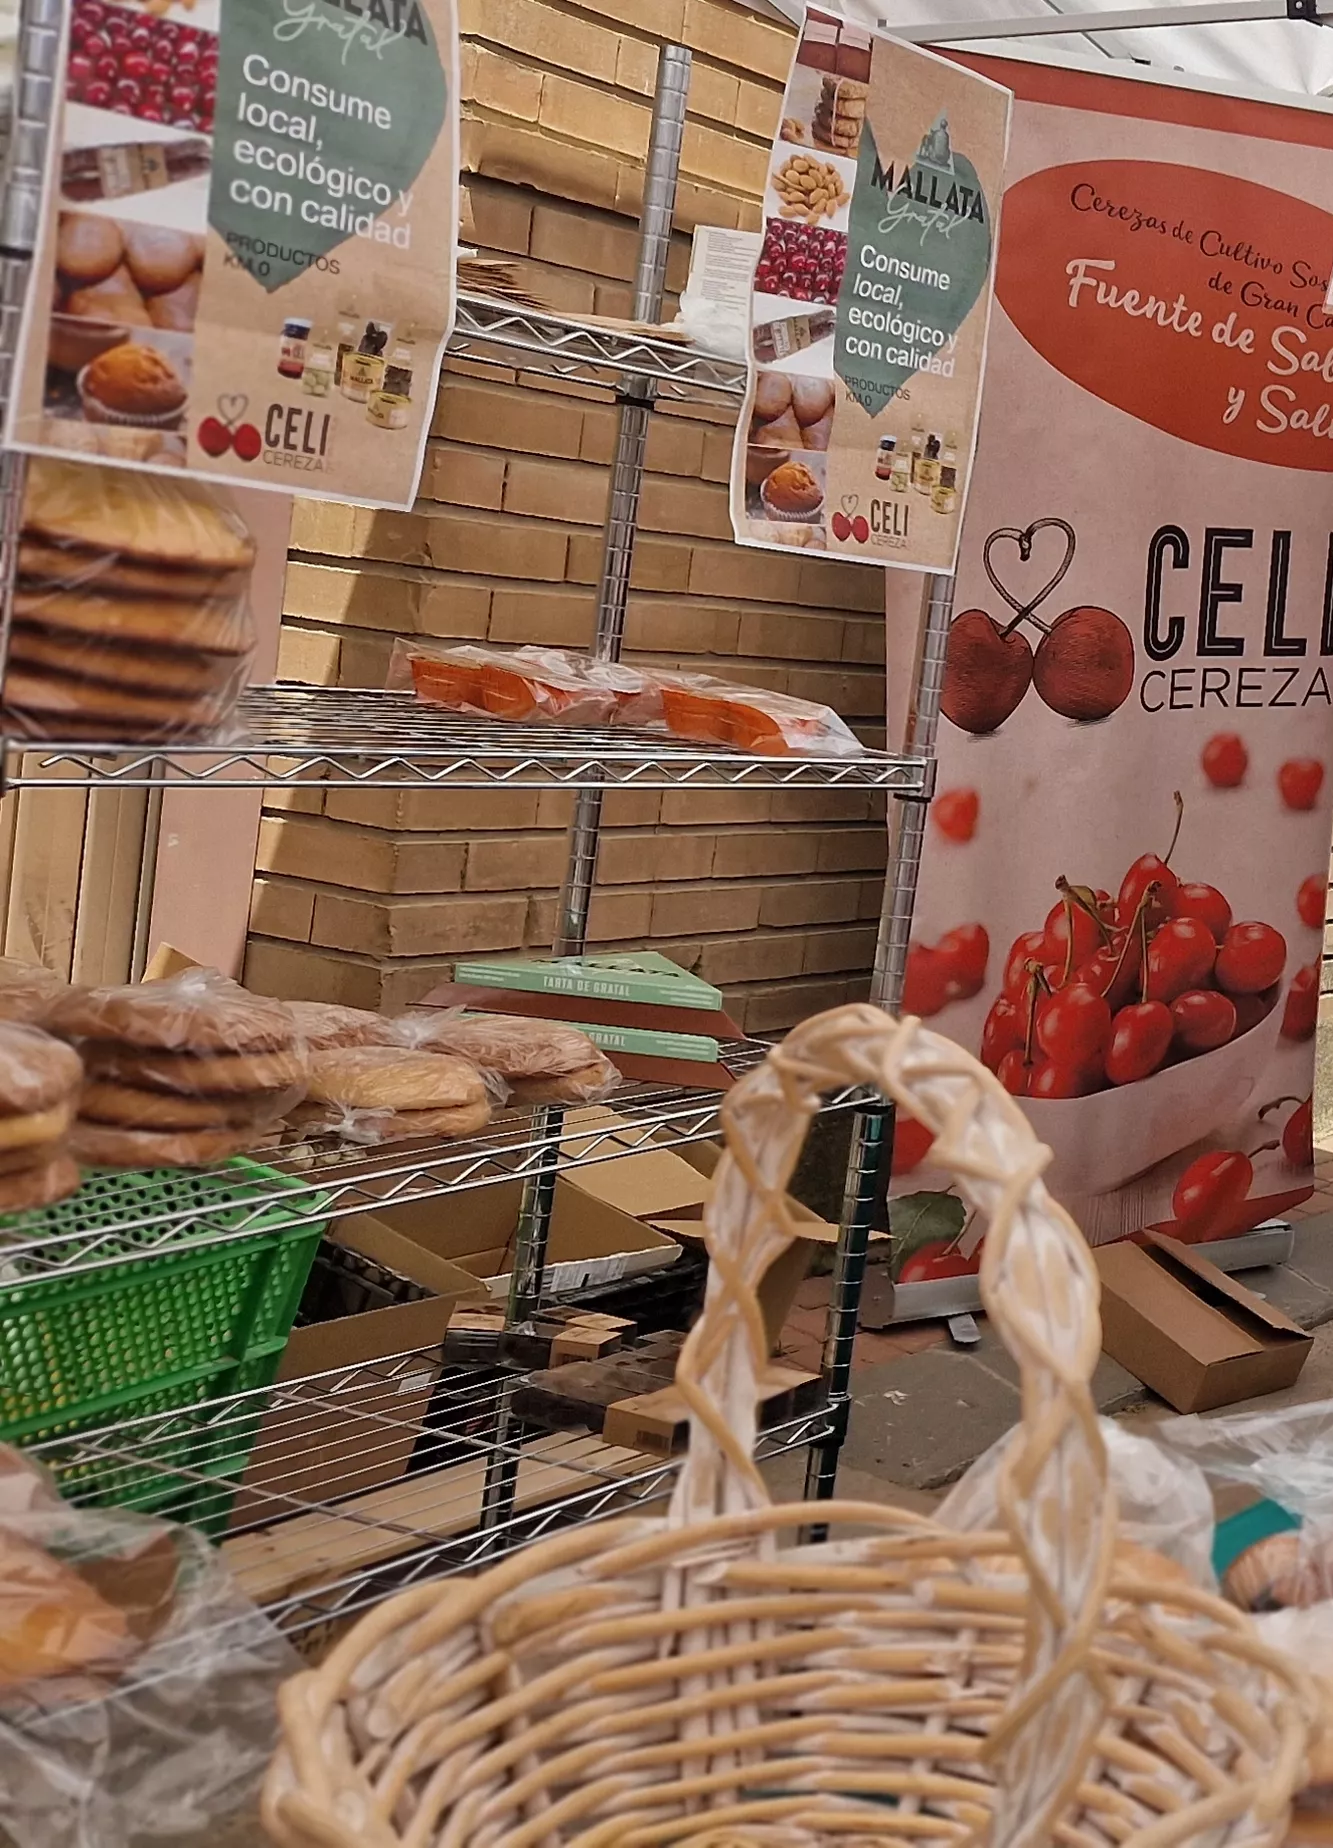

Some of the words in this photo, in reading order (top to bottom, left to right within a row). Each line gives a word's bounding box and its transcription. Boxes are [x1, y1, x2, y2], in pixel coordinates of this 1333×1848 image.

[242, 54, 392, 130] Consume
[237, 92, 323, 151] local,
[233, 139, 391, 206] ecológico
[398, 189, 413, 217] y
[870, 154, 984, 224] MALLATA
[230, 179, 292, 216] con
[301, 200, 411, 249] calidad
[1070, 183, 1167, 235] Cerezas
[1172, 220, 1193, 244] de
[1200, 230, 1284, 275] Cultivo
[226, 232, 341, 275] PRODUCTOS
[860, 244, 950, 290] Consume
[852, 273, 903, 310] local,
[1066, 258, 1203, 338] Fuente
[1211, 312, 1255, 354] de
[1208, 272, 1232, 295] de
[1240, 281, 1299, 317] Gran
[848, 306, 944, 346] ecológico
[948, 333, 958, 354] y
[845, 336, 882, 360] con
[886, 346, 955, 378] calidad
[845, 375, 911, 401] PRODUCTOS
[1222, 387, 1245, 424] y
[265, 403, 331, 456] CELI
[263, 449, 326, 473] CEREZA
[870, 499, 909, 536] CELI
[1140, 667, 1332, 713] CEREZA
[543, 975, 573, 990] TARTA
[577, 979, 589, 992] DE
[593, 981, 630, 997] GRATAL
